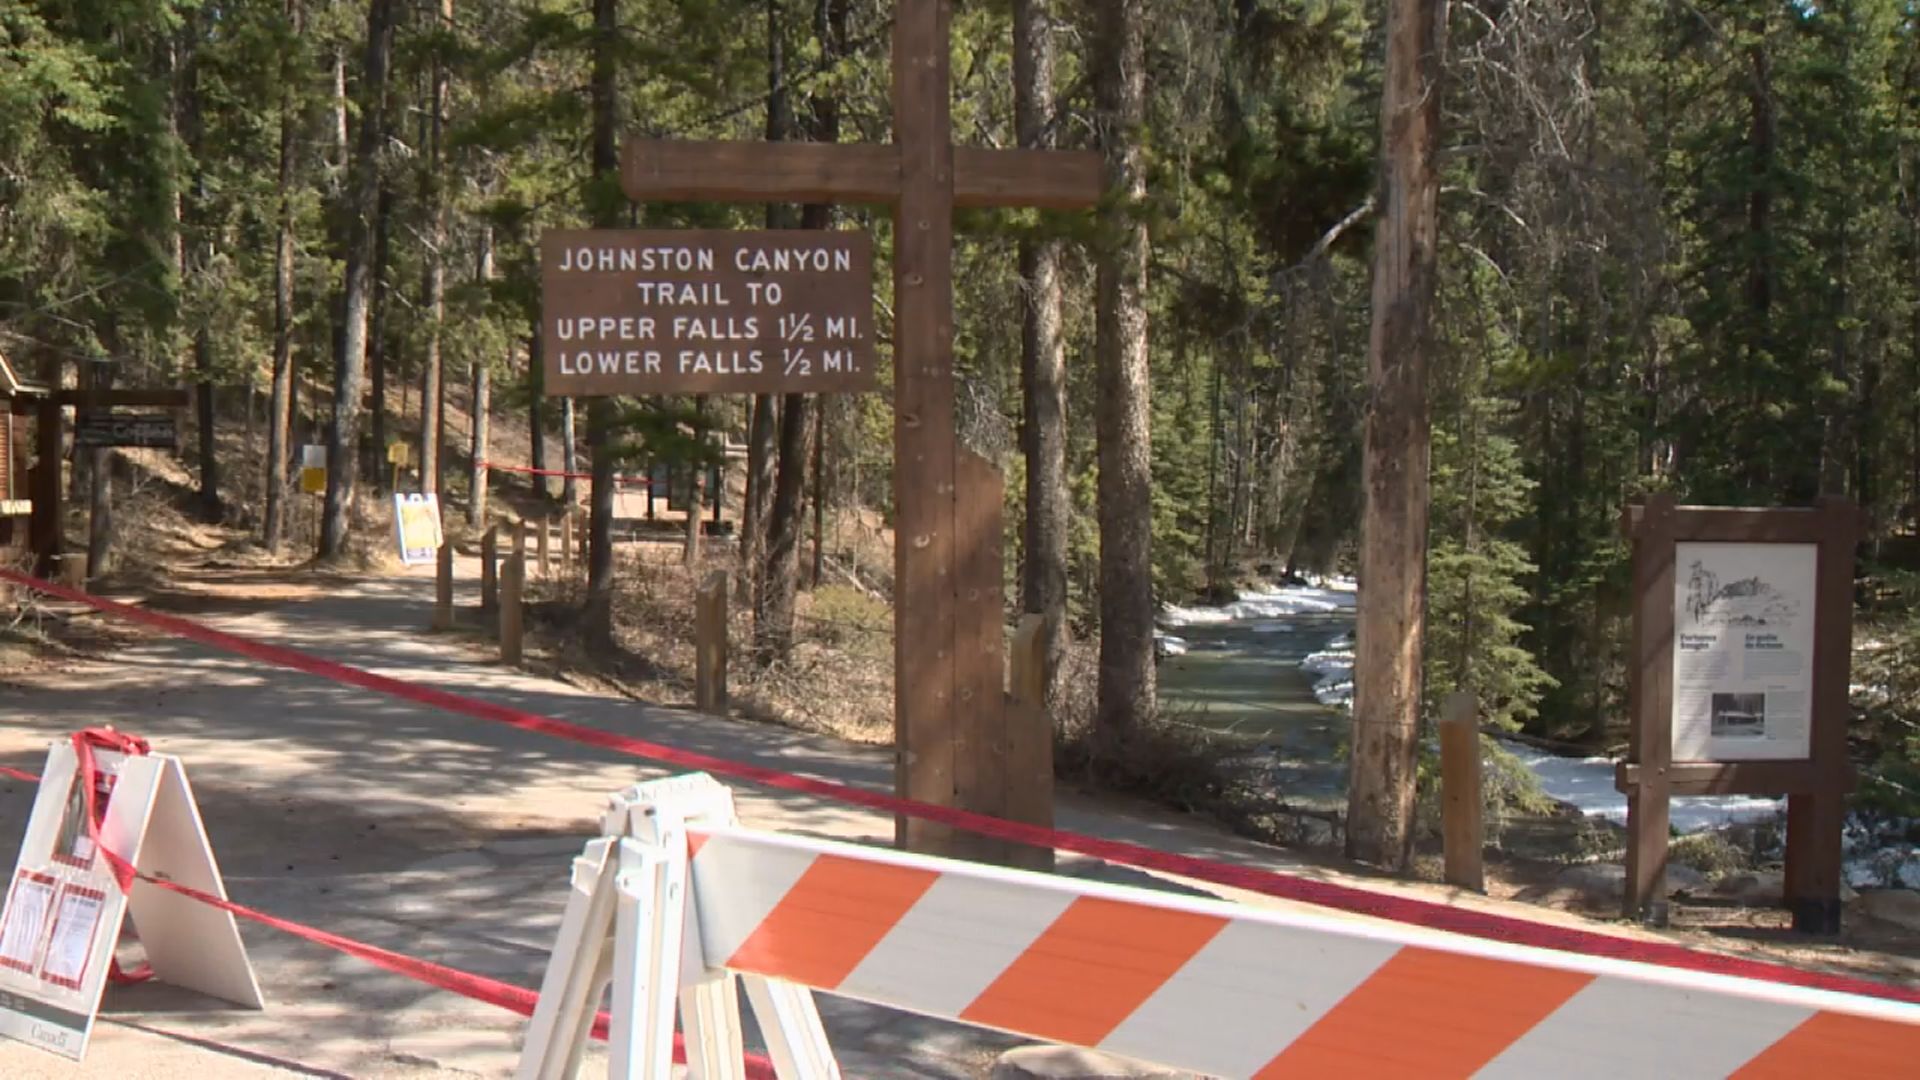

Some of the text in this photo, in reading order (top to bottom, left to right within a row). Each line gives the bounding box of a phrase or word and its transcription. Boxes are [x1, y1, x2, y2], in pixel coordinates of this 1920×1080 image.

[559, 248, 850, 272] JOHNSTON CANYON
[638, 282, 782, 306] TRAIL TO
[557, 317, 655, 340] UPPER
[673, 316, 759, 340] FALLS
[826, 316, 863, 339] MI.
[560, 351, 661, 375] LOWER
[679, 350, 763, 374] FALLS
[823, 350, 860, 373] MI.
